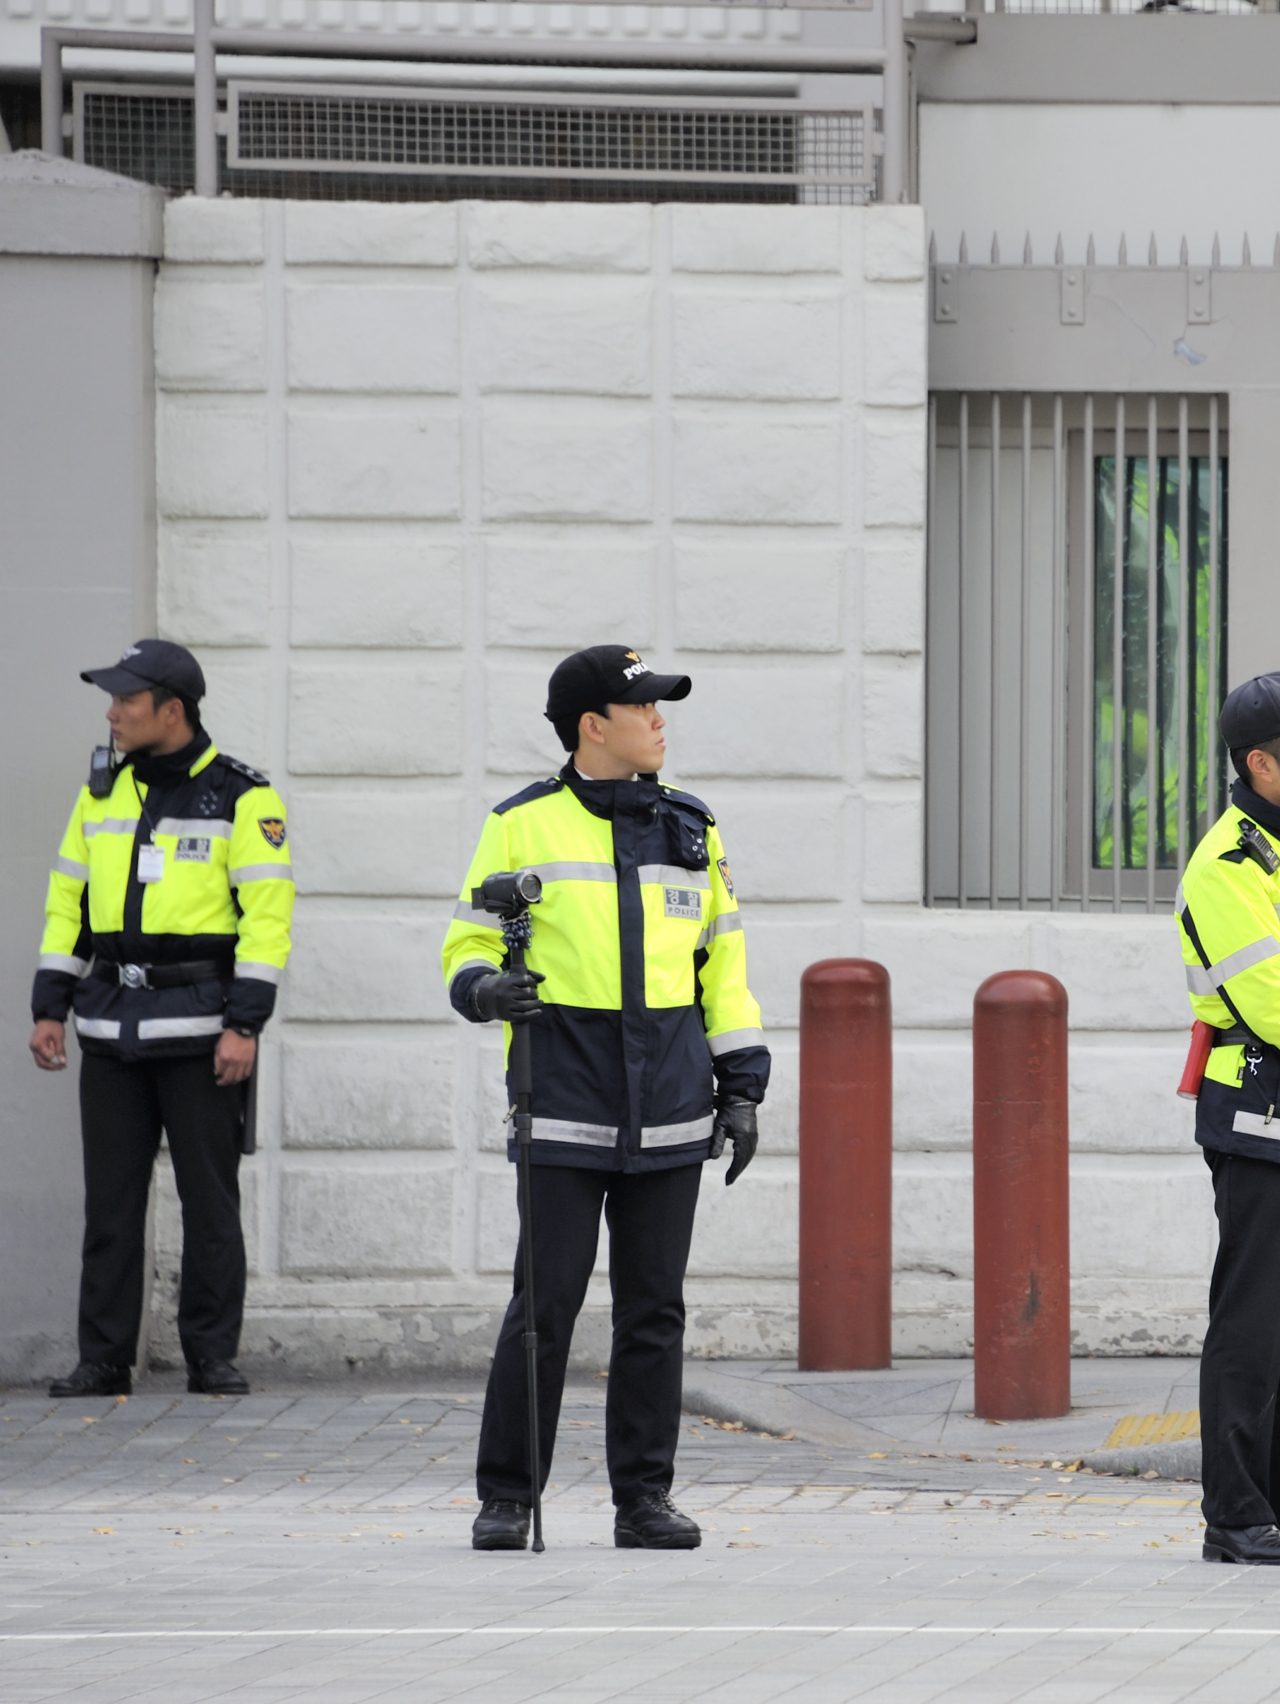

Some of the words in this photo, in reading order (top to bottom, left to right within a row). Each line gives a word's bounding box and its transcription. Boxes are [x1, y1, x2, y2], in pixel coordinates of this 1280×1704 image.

[623, 662, 648, 680] POLI
[667, 890, 699, 907] 경찰
[668, 907, 700, 917] POLICE
